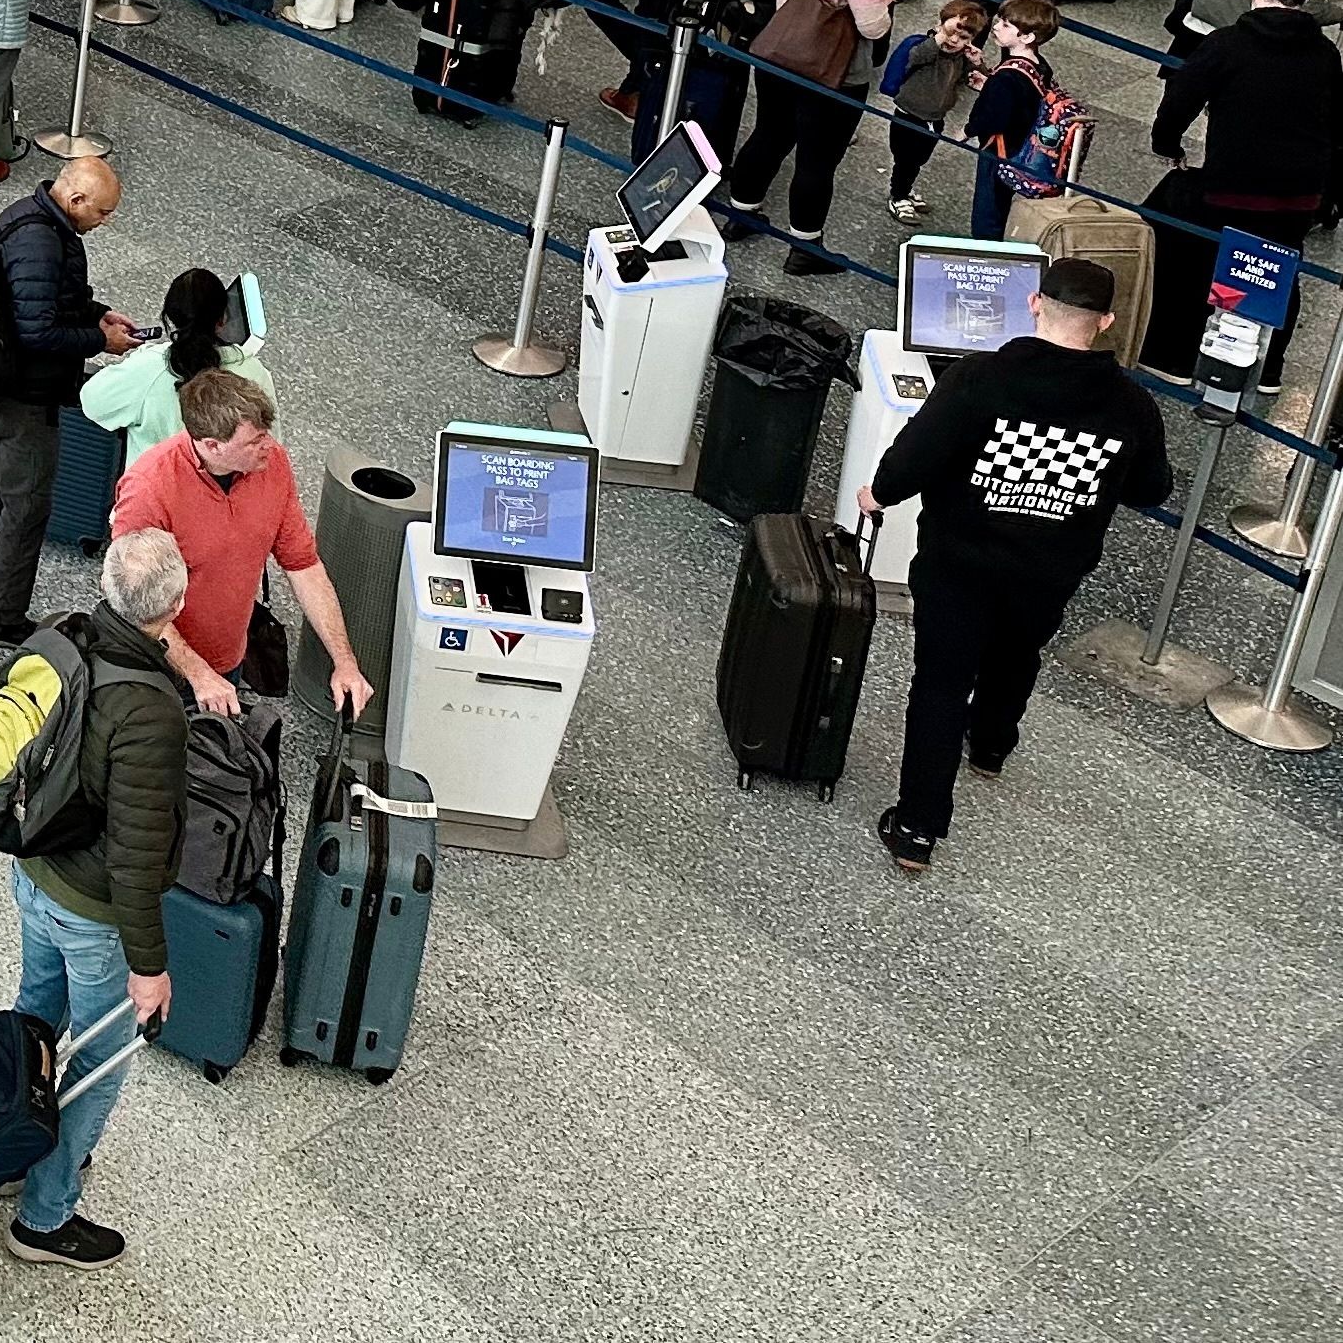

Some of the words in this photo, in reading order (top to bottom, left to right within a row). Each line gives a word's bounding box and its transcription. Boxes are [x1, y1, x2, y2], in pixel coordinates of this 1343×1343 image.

[1233, 250, 1257, 264] STAY
[1258, 258, 1280, 273] SAFE
[943, 263, 966, 273] SCAN
[967, 265, 1010, 277] BOARDING
[1245, 264, 1264, 276] AND
[948, 272, 968, 281] PASS
[969, 274, 980, 282] TO
[981, 275, 1005, 284] PRINT
[1230, 267, 1277, 290] SANITIZED
[956, 282, 974, 291] BAG
[975, 283, 996, 292] TAGS
[481, 455, 506, 466] SCAN
[508, 458, 554, 471] BOARDING
[486, 466, 507, 476] PASS
[510, 468, 522, 476] TO
[524, 469, 550, 480] PRINT
[495, 476, 514, 486] BAG
[517, 479, 538, 488] TAGS
[970, 473, 1097, 506] DITCHBANGER
[984, 491, 1073, 515] NATIONAL
[462, 704, 520, 720] DELTA
